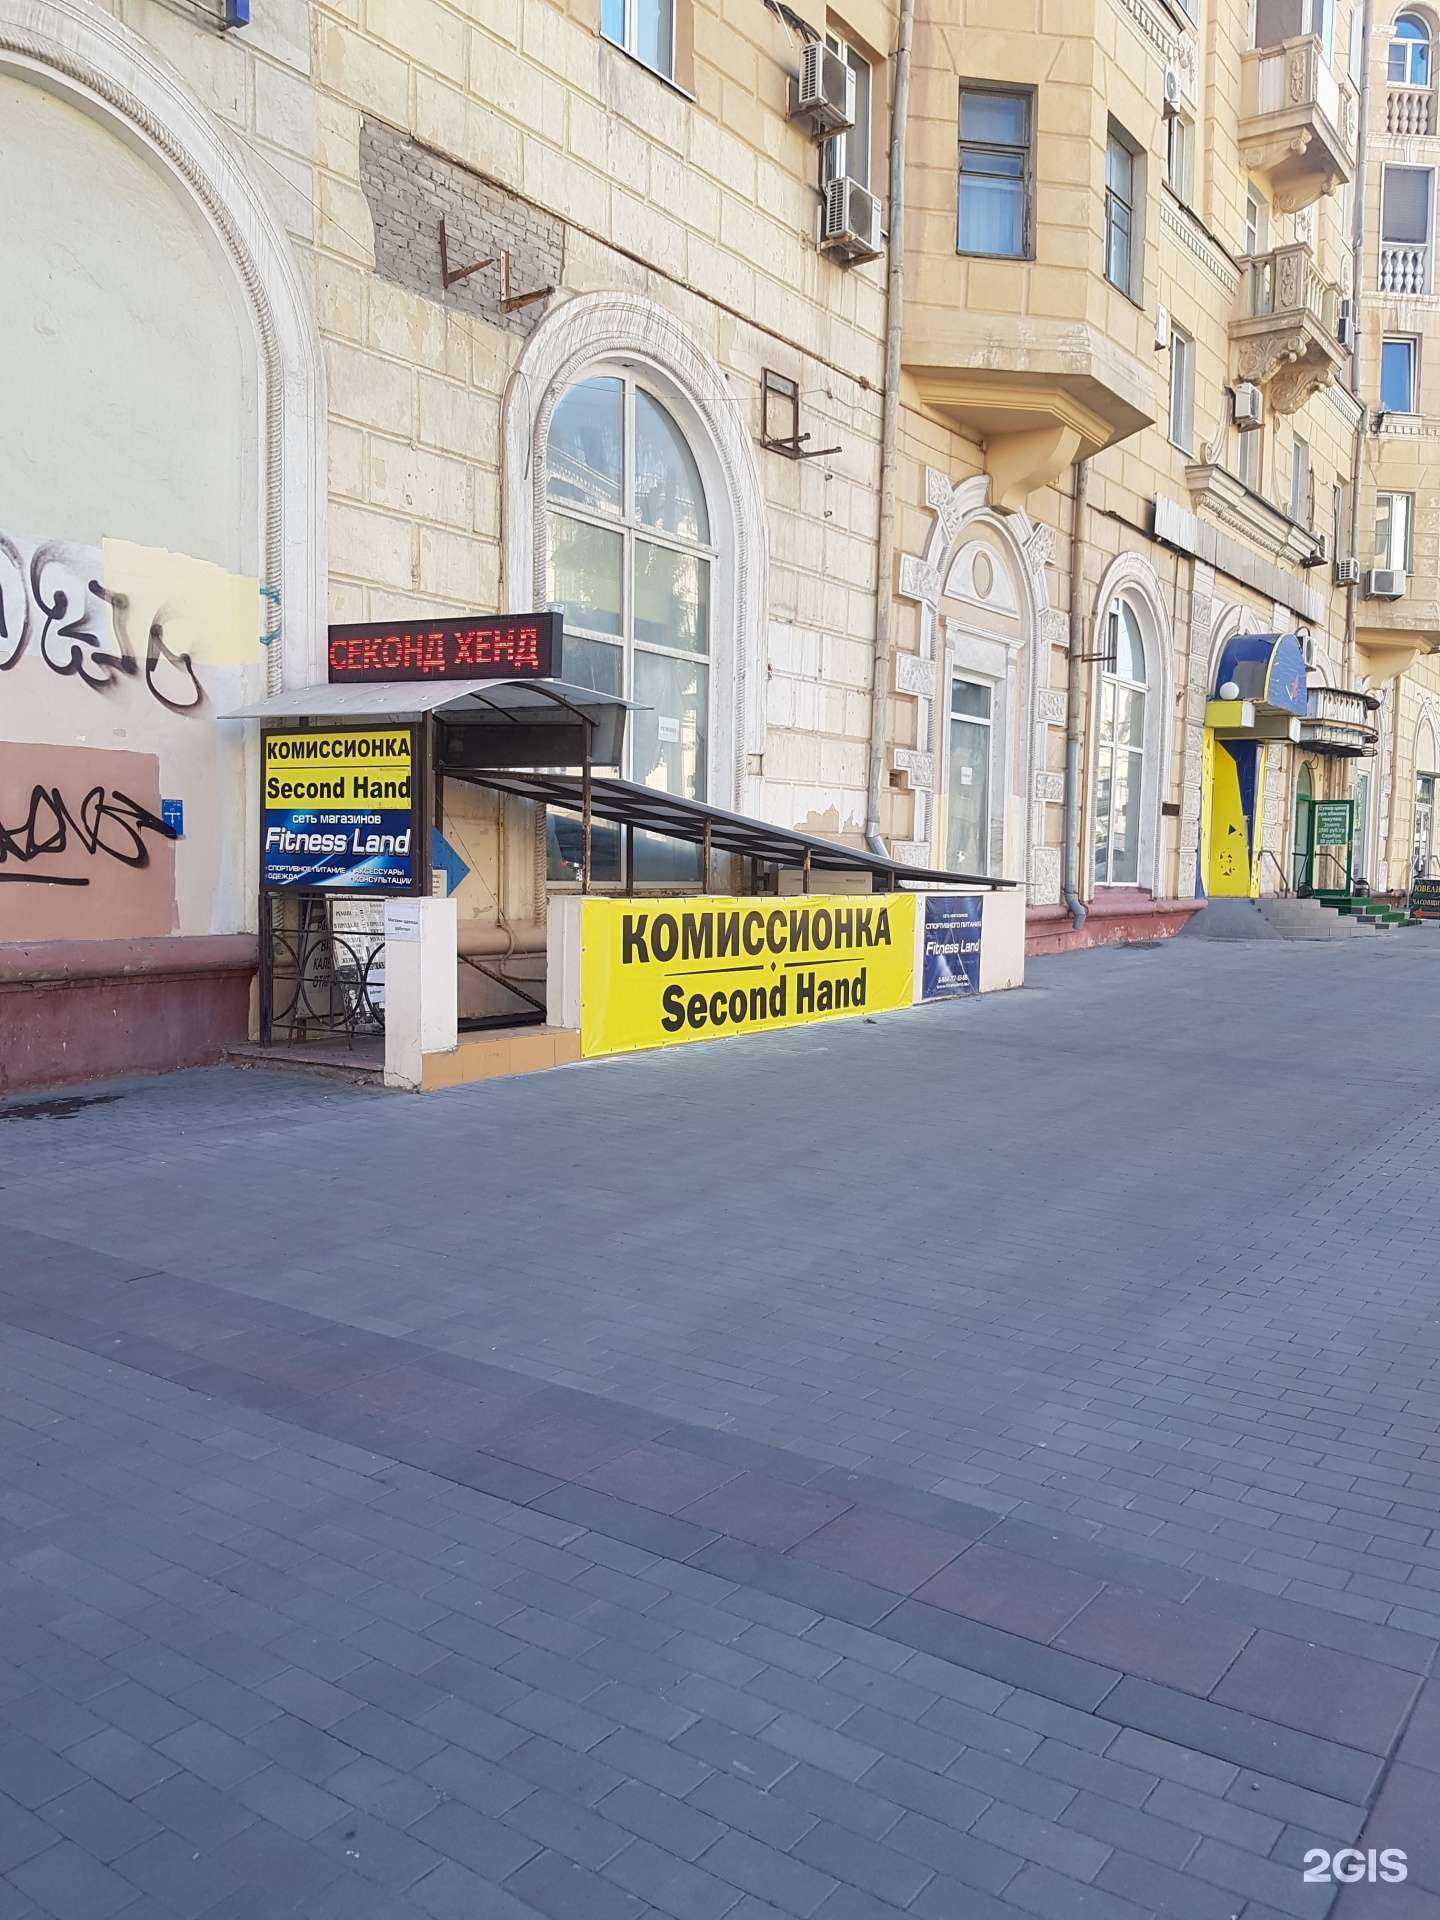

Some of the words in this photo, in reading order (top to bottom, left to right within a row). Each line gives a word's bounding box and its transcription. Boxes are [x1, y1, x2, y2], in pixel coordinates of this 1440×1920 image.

[330, 632, 445, 673] СЕКОНД
[454, 627, 540, 672] ХЕНД
[267, 737, 411, 760] КОМИССИОНКА
[267, 776, 345, 799] Second
[353, 775, 411, 798] Hand
[292, 815, 317, 824] сеть
[320, 814, 382, 825] магазинов
[266, 826, 348, 854] Fitness
[352, 827, 412, 856] Land
[267, 872, 299, 881] ОДЕЖДА
[622, 907, 892, 965] КОМИССИОНКА
[926, 941, 959, 955] Fitness
[960, 939, 980, 953] Land
[661, 974, 787, 1033] Second
[796, 967, 867, 1015] Hand
